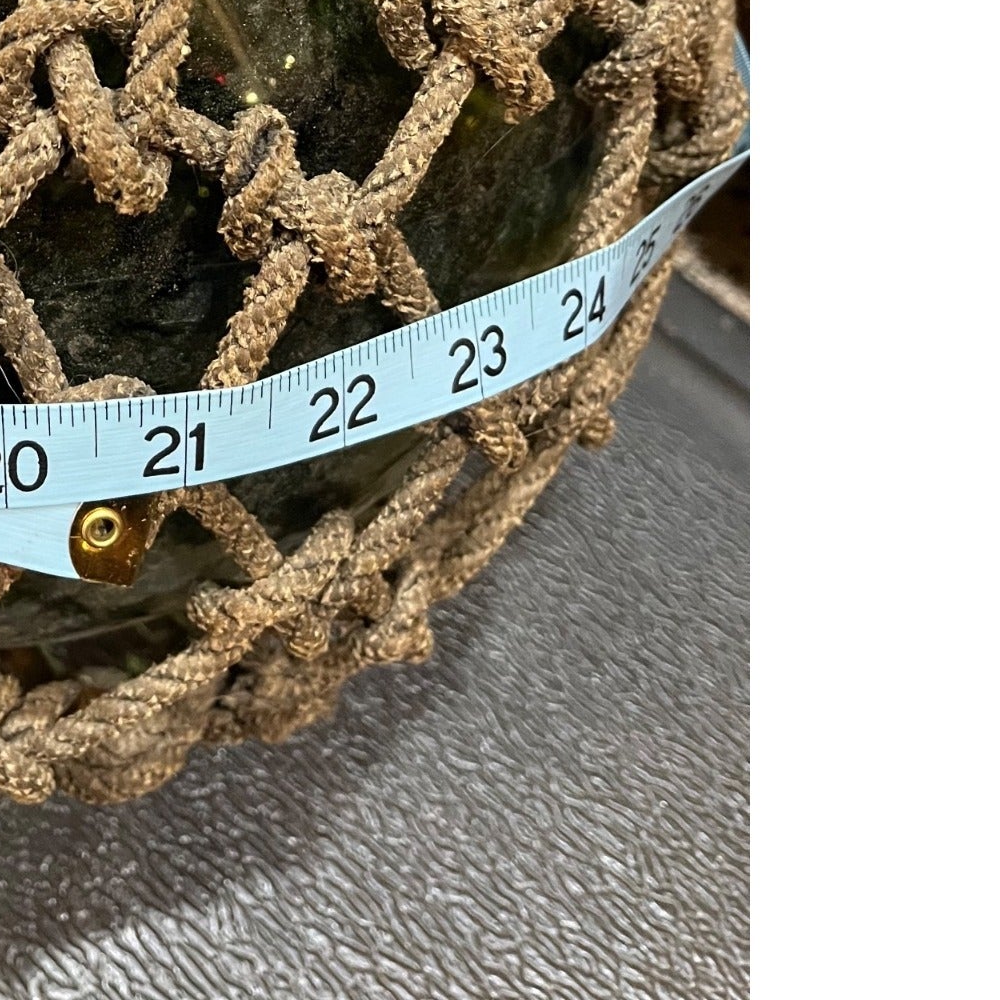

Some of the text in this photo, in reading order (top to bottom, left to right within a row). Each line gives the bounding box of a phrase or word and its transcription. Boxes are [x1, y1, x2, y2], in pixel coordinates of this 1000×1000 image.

[142, 421, 206, 478] 21
[308, 373, 378, 443] 22
[448, 324, 508, 395] 23
[560, 275, 606, 342] 24
[630, 225, 662, 286] 25
